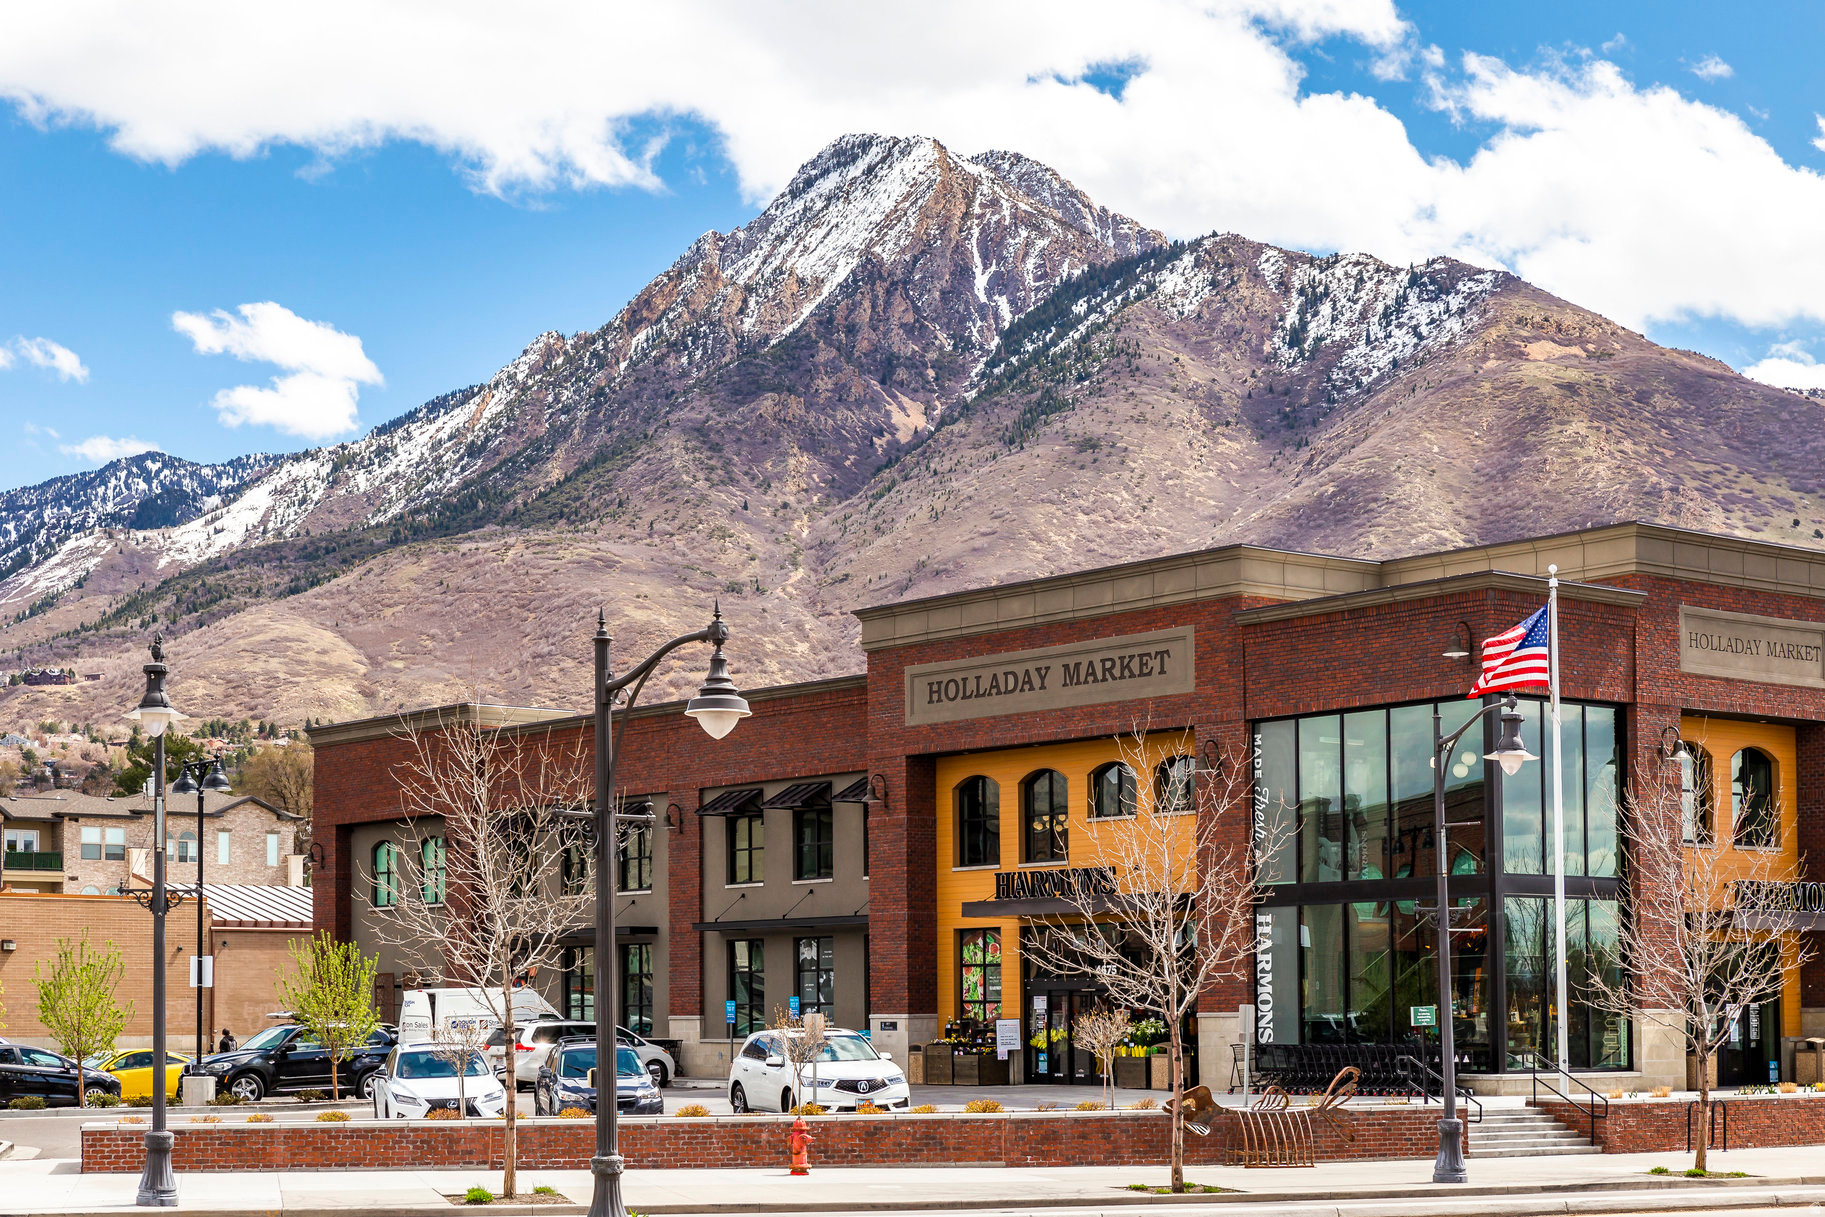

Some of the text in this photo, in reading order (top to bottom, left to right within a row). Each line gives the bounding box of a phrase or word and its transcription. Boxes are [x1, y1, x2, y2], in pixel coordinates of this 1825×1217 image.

[1688, 631, 1822, 663] HOLLADAY MARKET
[927, 649, 1171, 704] HOLLADAY MARKET
[1254, 734, 1262, 779] MADE
[1254, 786, 1270, 842] Fresh
[994, 866, 1116, 899] HARMONS
[1734, 880, 1825, 912] HARMO
[1257, 913, 1274, 1044] HARMONS
